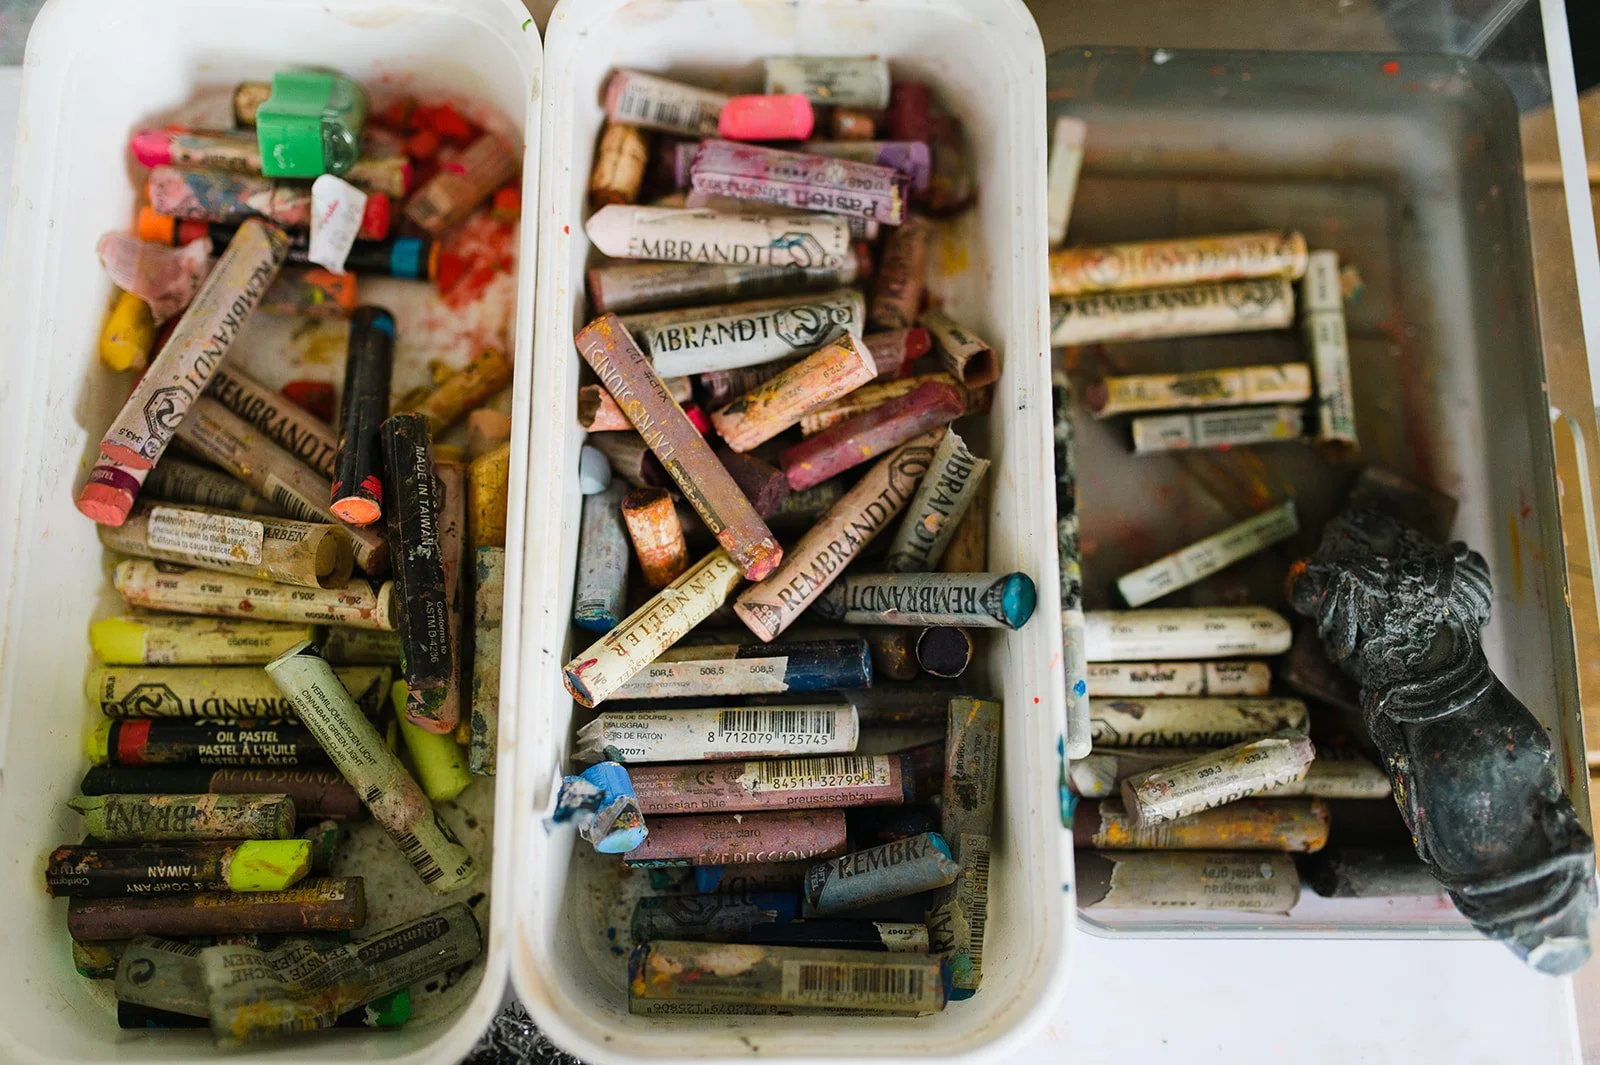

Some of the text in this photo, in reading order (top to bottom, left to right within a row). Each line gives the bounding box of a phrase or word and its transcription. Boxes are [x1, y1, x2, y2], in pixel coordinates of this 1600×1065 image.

[118, 427, 144, 445] 343,5
[415, 446, 427, 480] MADE
[418, 483, 428, 495] IN
[778, 488, 898, 611] REMBRANDT
[850, 586, 977, 614] REMBRANDT
[425, 600, 435, 629] ASTM
[609, 558, 730, 660] SENNELIER
[437, 601, 447, 643] Conforms
[699, 666, 725, 676] 508,5
[749, 664, 774, 675] 508,5
[292, 694, 310, 714] VERT
[328, 741, 348, 763] CLAIR
[300, 689, 364, 768] CINNABAR GREEN LIGHT
[308, 682, 377, 767] VERMILJOENGROEN LICHT
[217, 731, 279, 743] OIL PASTEL
[637, 731, 663, 740] RATÓN
[707, 731, 829, 746] 8 712079 125745
[198, 745, 239, 755] PASTEL
[253, 744, 297, 755] L'HUILE
[1244, 750, 1269, 765] 339,3
[1197, 764, 1223, 780] 339,3
[772, 775, 813, 791] 84511
[701, 798, 726, 809] blue
[736, 828, 761, 839] claro
[966, 838, 978, 846] 8
[147, 864, 198, 879] TAIWAN
